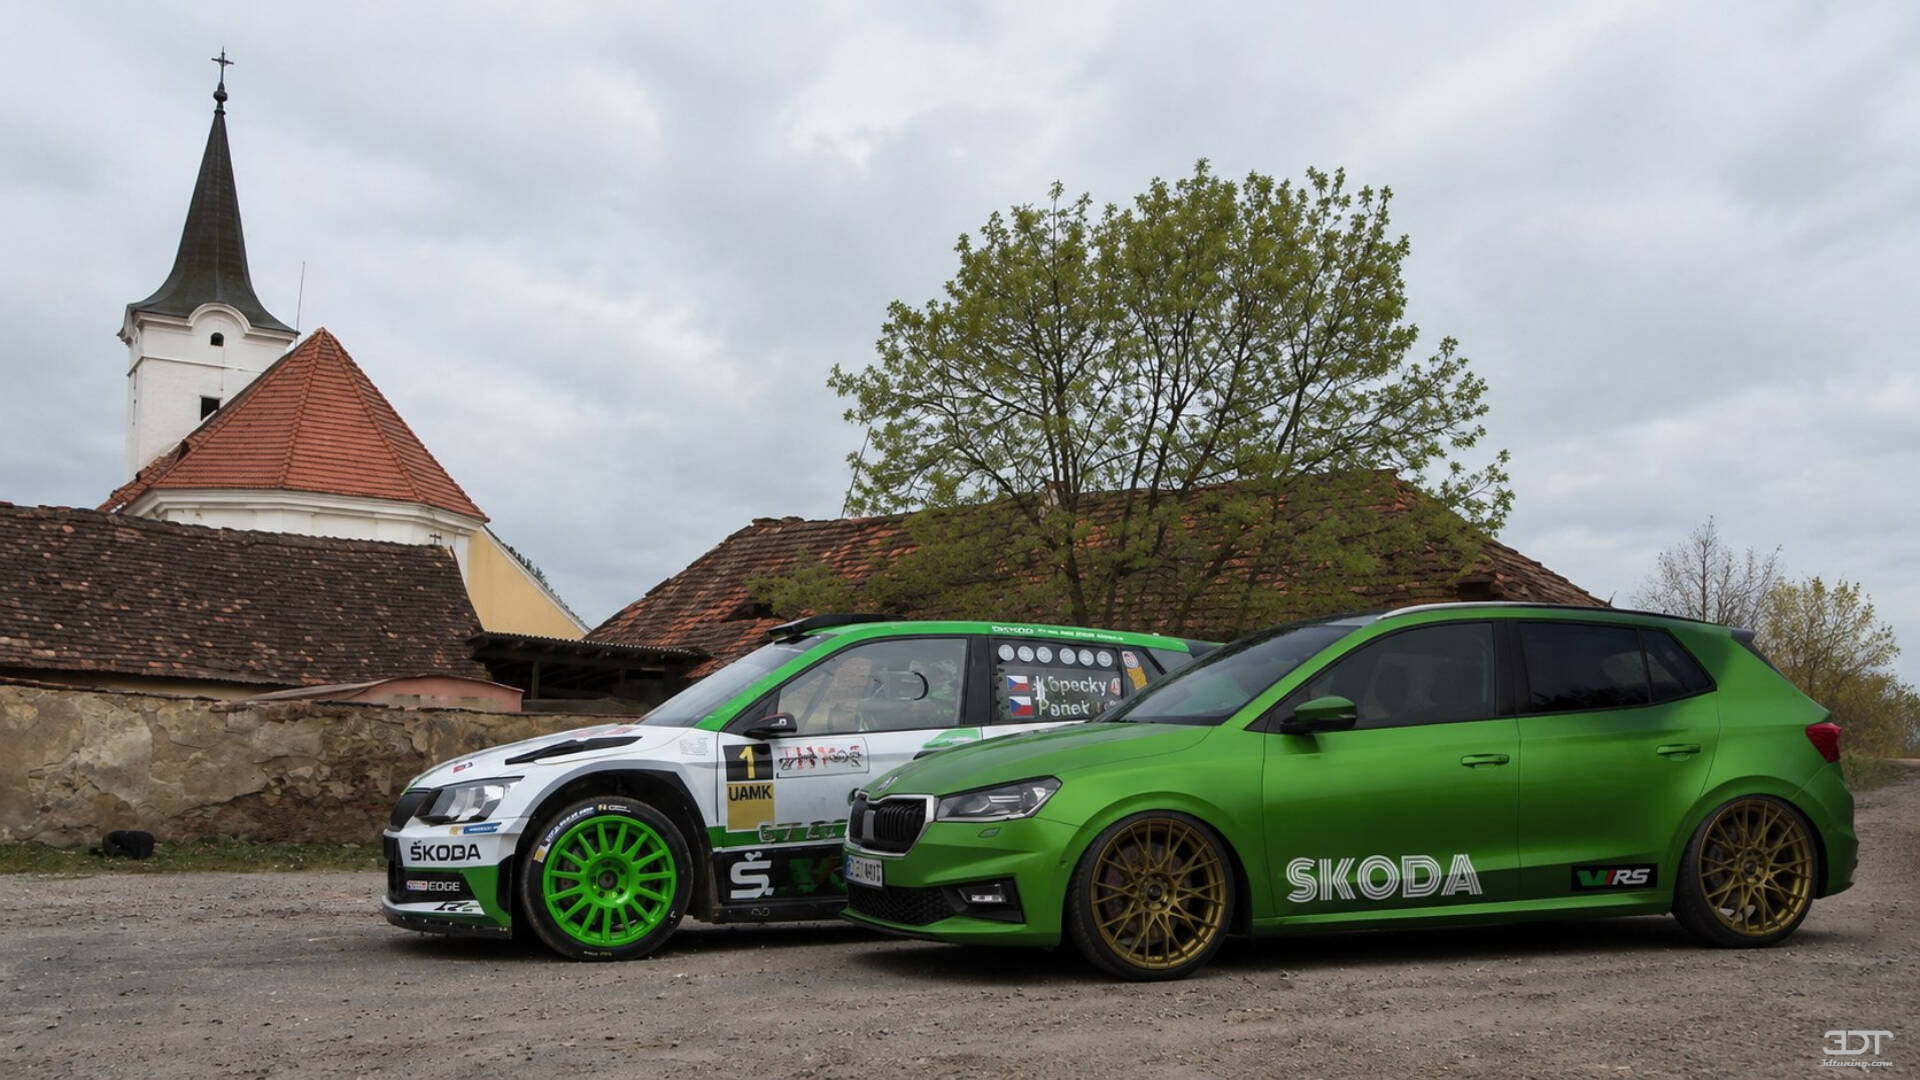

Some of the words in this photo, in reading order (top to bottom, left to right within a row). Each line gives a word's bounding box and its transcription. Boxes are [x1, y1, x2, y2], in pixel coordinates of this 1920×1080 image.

[739, 745, 756, 779] 1
[729, 785, 772, 801] UAMK
[1285, 853, 1483, 903] SKODA
